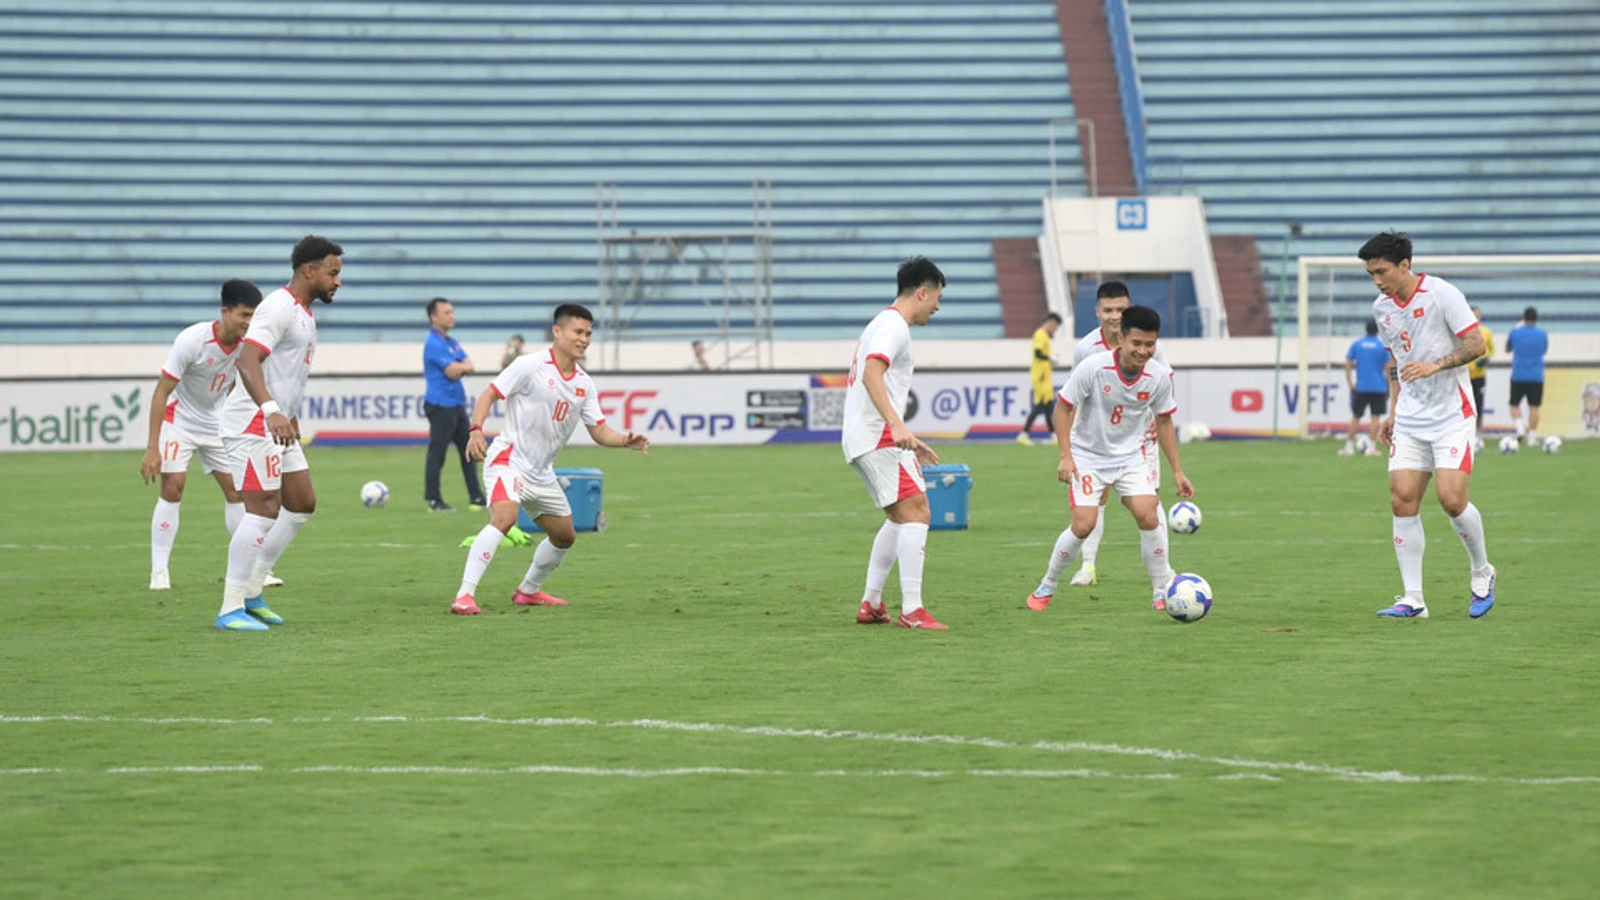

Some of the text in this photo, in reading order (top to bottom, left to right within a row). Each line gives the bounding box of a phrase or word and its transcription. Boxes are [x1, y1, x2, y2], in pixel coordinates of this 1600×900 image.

[1120, 204, 1144, 226] C3
[210, 373, 227, 392] 17
[1283, 384, 1340, 415] VFF
[552, 400, 569, 421] 10
[1111, 405, 1123, 425] 8
[164, 441, 179, 460] 17
[265, 455, 281, 478] 12
[1081, 475, 1093, 496] 8
